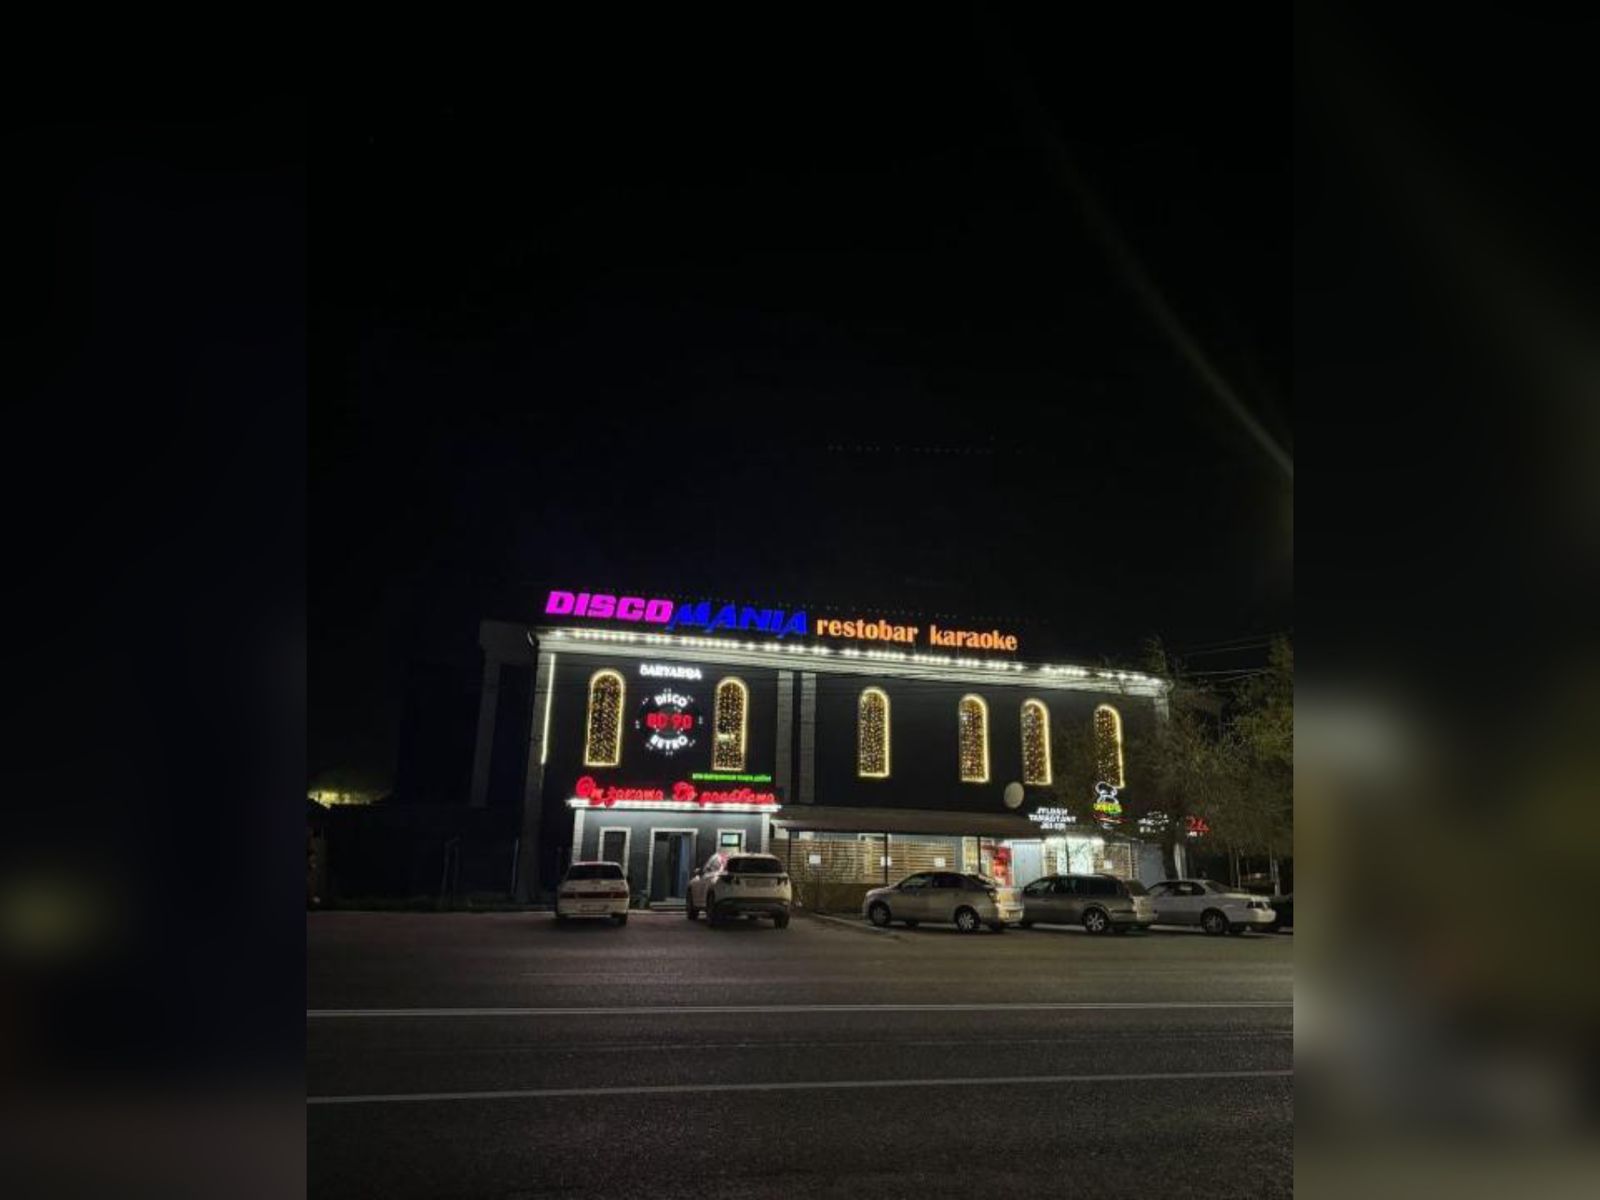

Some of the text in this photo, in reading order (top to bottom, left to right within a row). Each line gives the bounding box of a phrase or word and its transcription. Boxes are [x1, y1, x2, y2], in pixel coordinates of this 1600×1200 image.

[816, 618, 919, 643] restobar
[930, 624, 1018, 651] karaoke
[650, 734, 688, 749] RETRO
